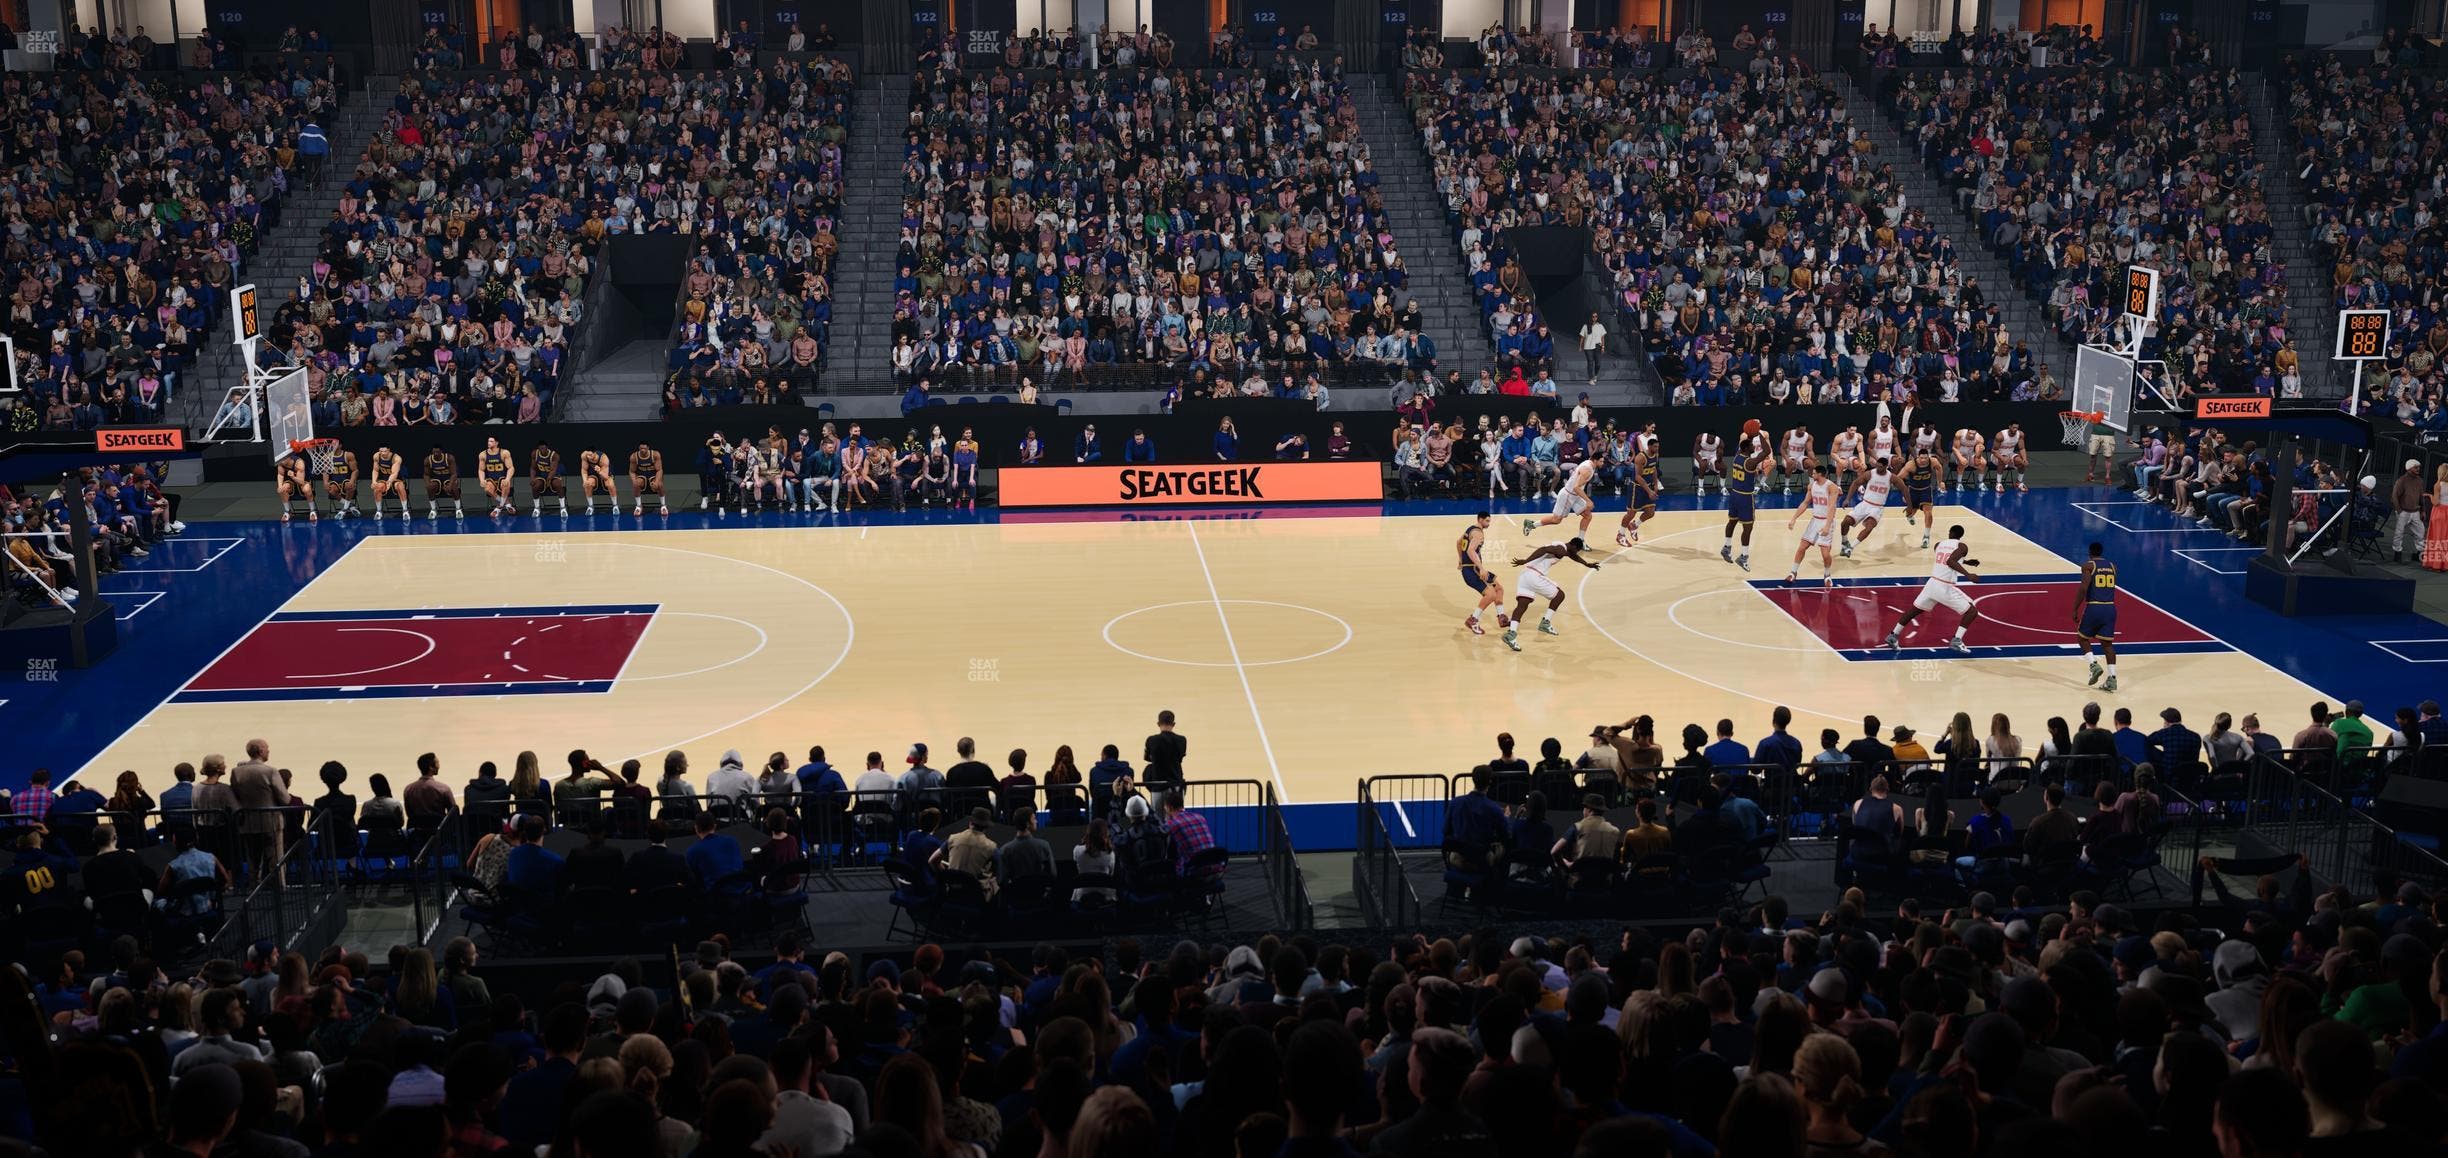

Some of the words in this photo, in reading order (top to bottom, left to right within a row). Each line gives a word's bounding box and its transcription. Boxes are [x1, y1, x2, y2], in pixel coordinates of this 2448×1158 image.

[219, 12, 243, 22] 120
[423, 12, 446, 22] 121
[776, 12, 798, 22] 121
[914, 12, 937, 22] 122
[1253, 12, 1276, 22] 122
[1384, 12, 1406, 22] 123
[1765, 12, 1787, 22] 123
[1841, 12, 1862, 22] 124
[2131, 289, 2145, 313] 88
[2351, 316, 2365, 329] 88
[2367, 316, 2382, 329] 88
[2351, 332, 2377, 354] 88
[2206, 402, 2262, 414] SEATGEEK
[105, 433, 175, 447] SEATGEEK
[1119, 466, 1264, 500] SEATGEEK
[2095, 574, 2115, 588] 00
[25, 866, 55, 895] 00
